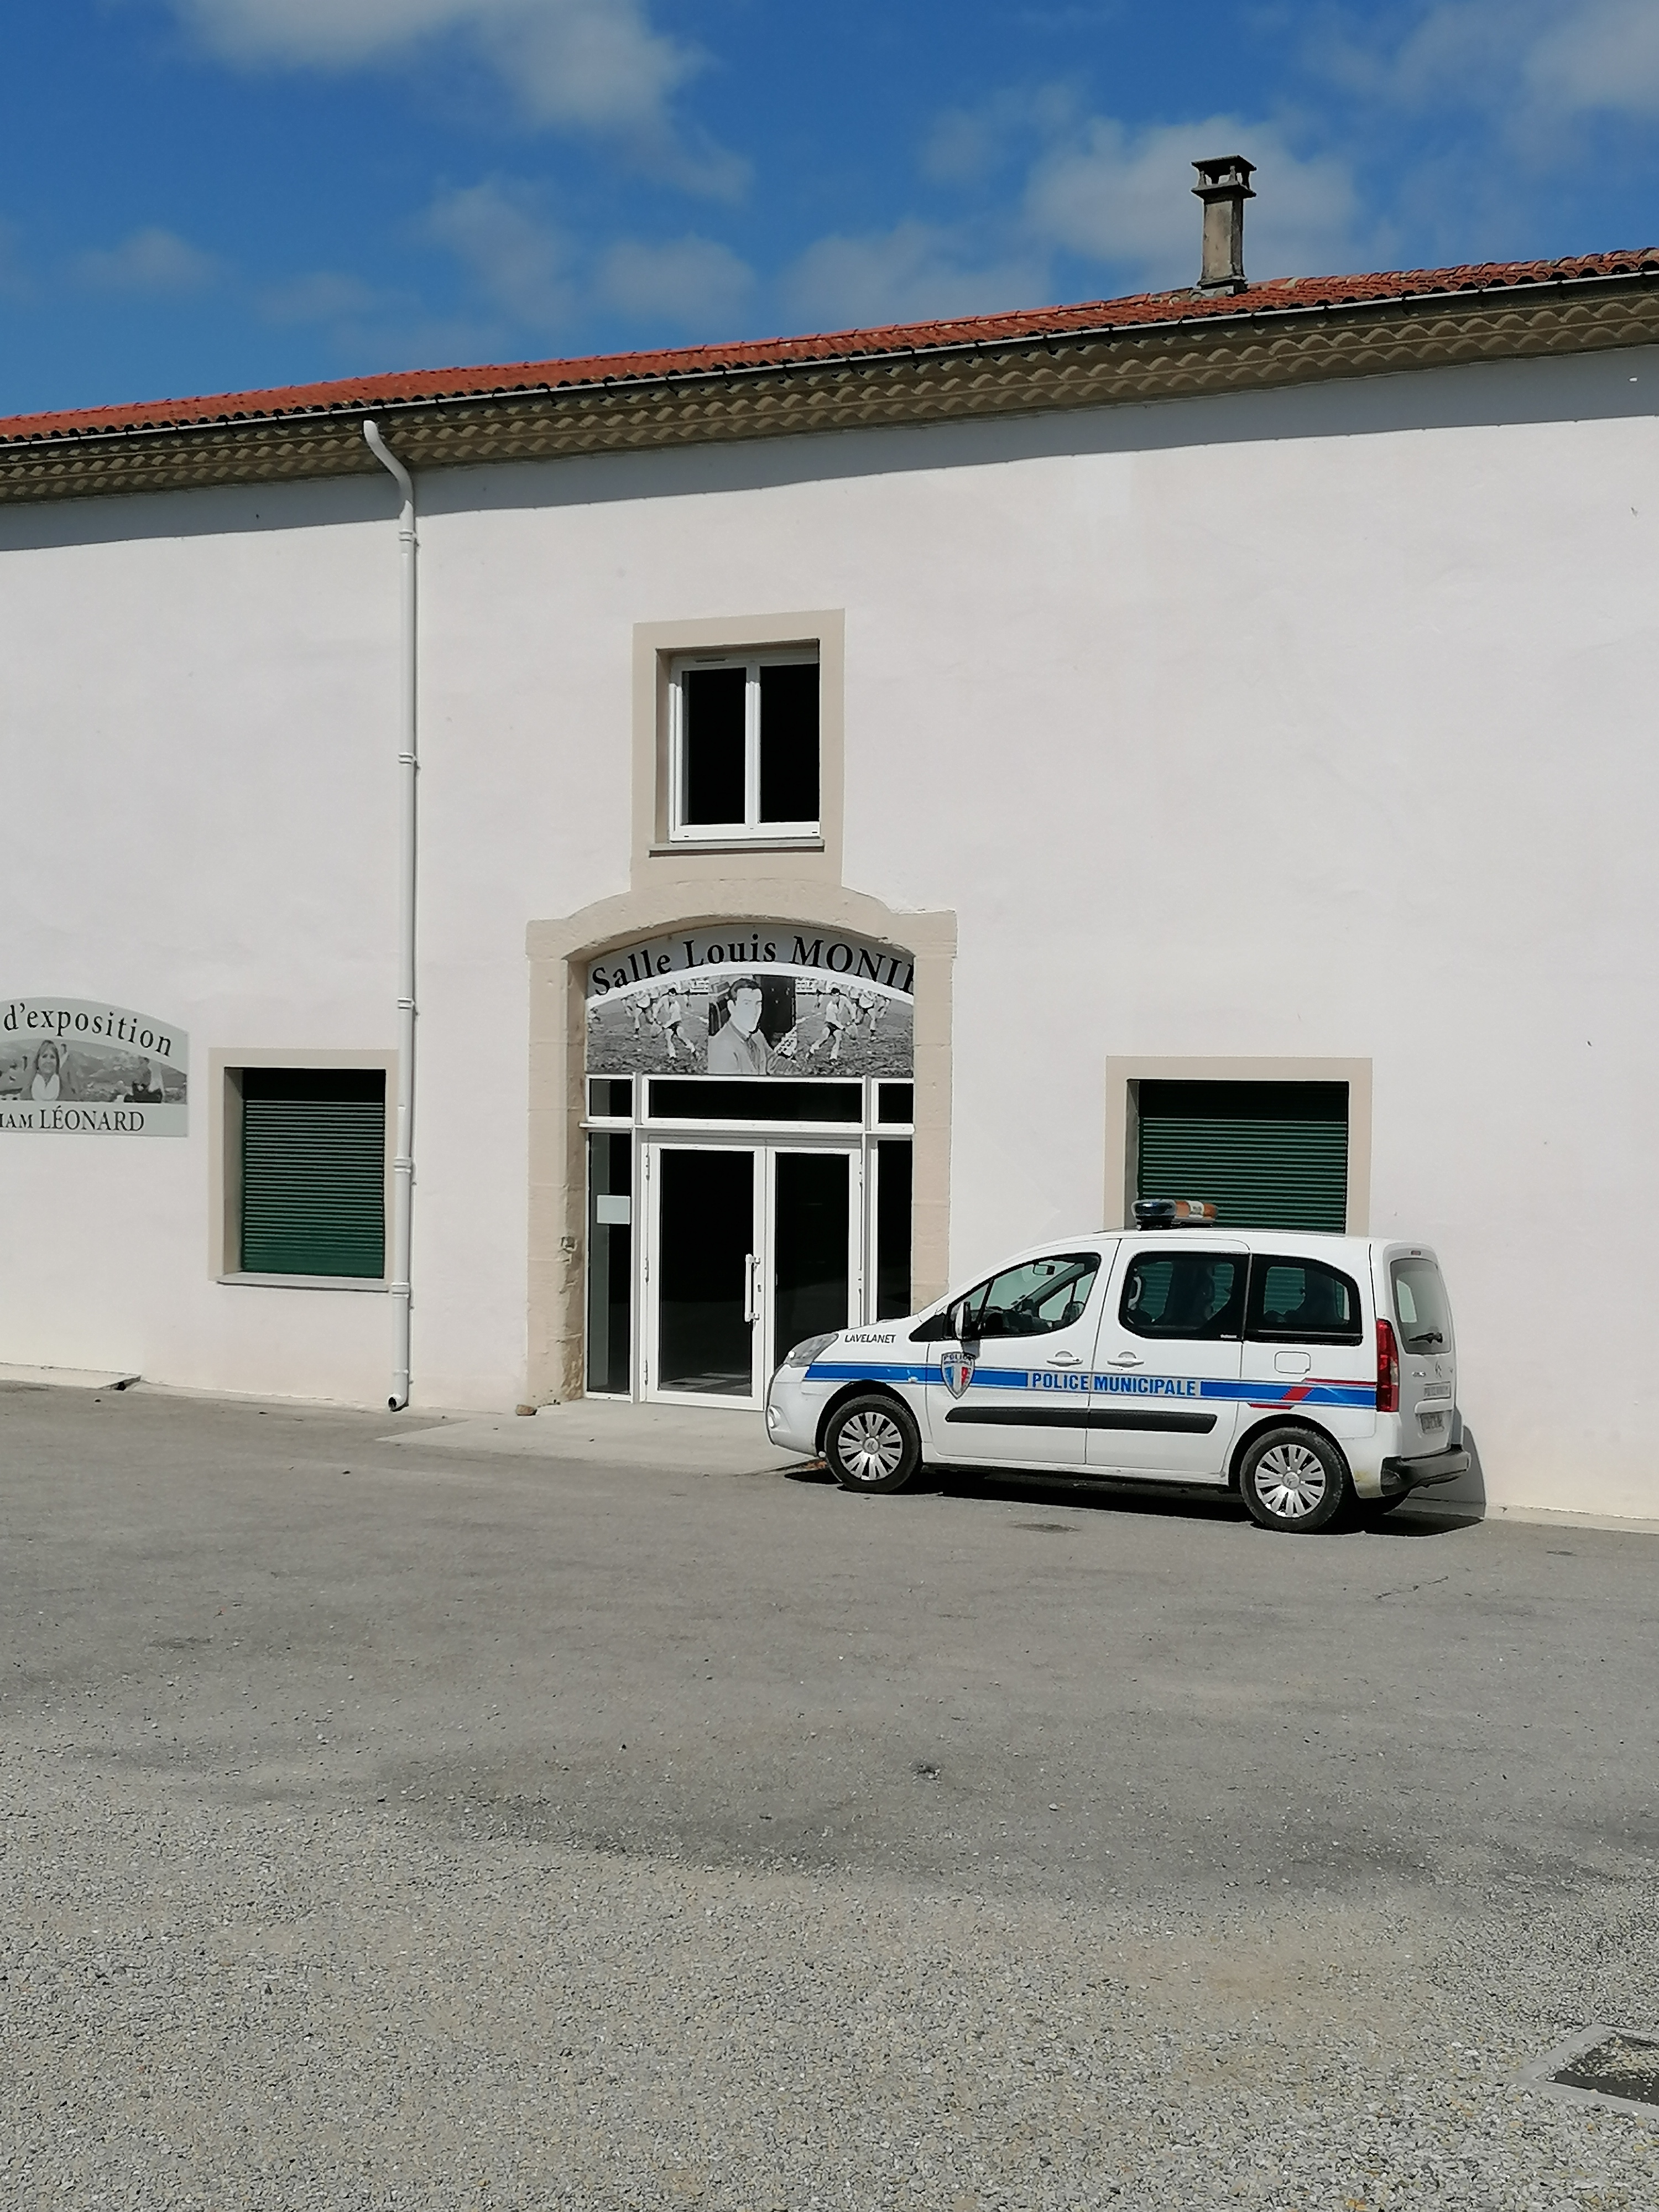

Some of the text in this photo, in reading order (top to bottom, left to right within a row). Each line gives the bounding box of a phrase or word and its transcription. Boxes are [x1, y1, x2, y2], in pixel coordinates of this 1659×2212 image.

[592, 950, 672, 996] Salle
[683, 933, 776, 969] Louis
[39, 1105, 144, 1131] LÉONARD
[844, 1334, 896, 1343] LAVELANET
[1032, 1372, 1196, 1396] POLICE MUNICIPALE
